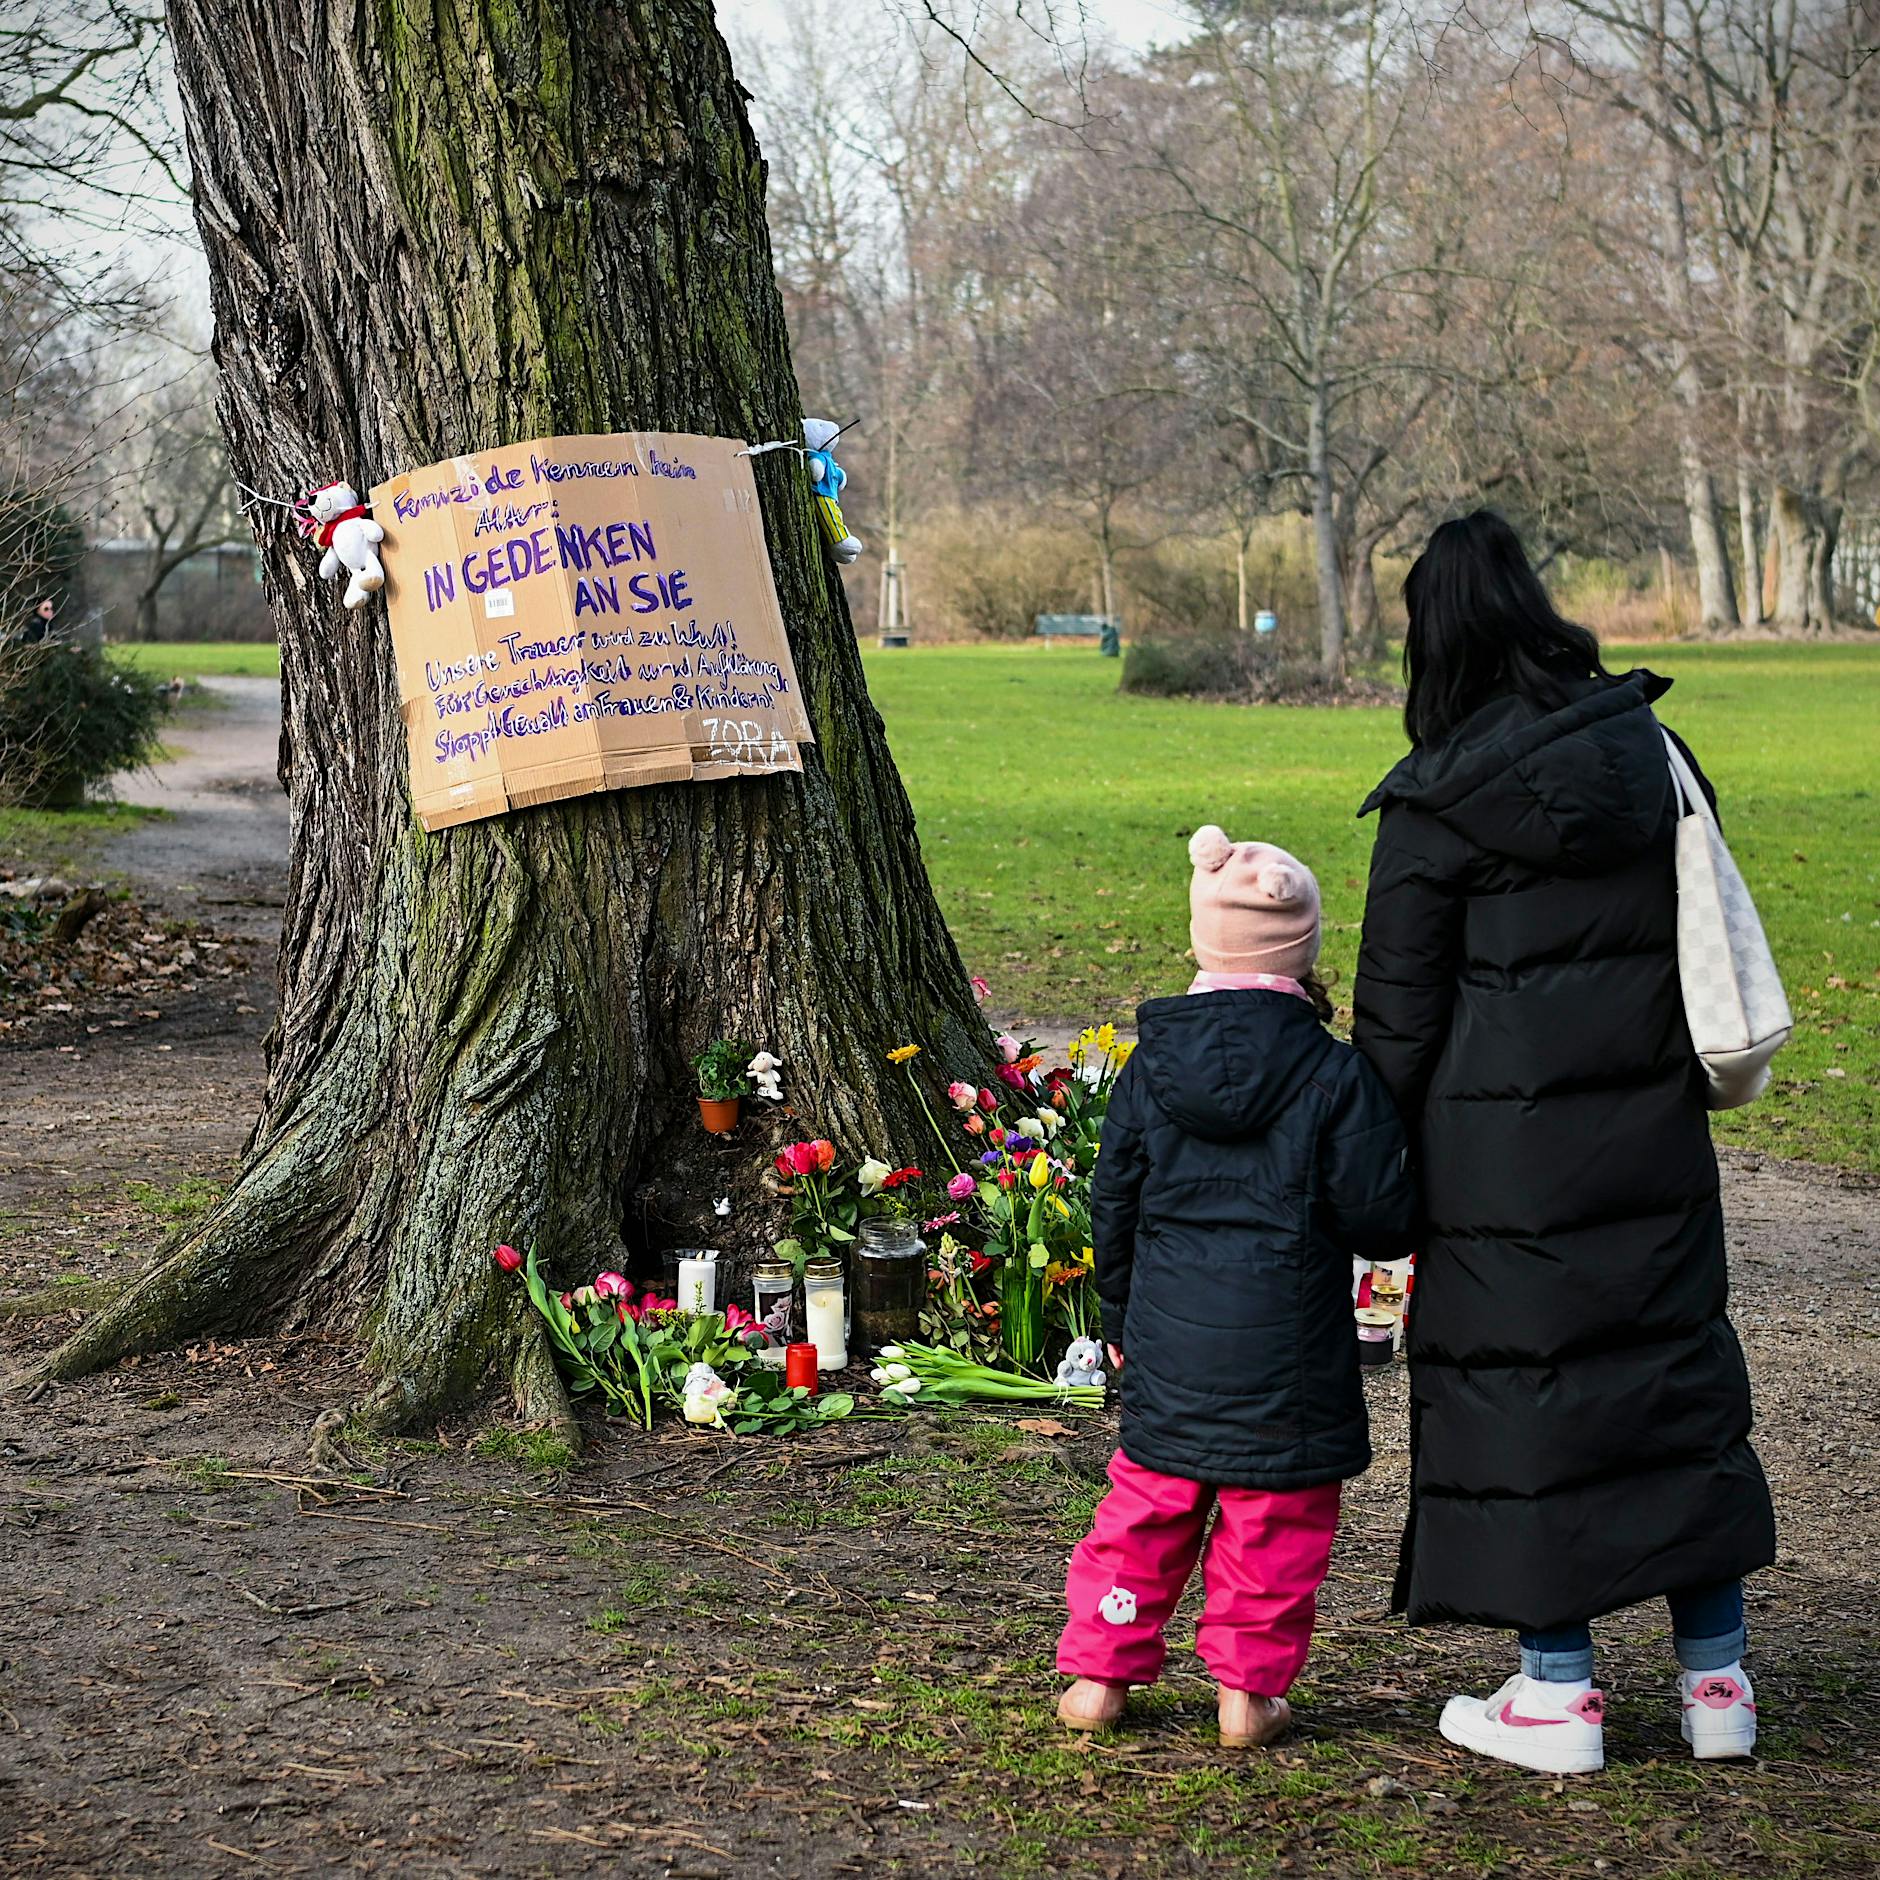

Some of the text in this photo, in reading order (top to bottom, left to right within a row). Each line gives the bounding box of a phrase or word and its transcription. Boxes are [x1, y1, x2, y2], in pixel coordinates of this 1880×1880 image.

[424, 563, 455, 612] IN
[461, 520, 656, 595] GEDENKEN
[574, 569, 693, 618] AN SIE
[425, 619, 738, 692] Unsere Trauer wird zu Wut!
[638, 653, 694, 682] und
[573, 703, 600, 723] an
[695, 682, 776, 711] Kindern!
[702, 717, 796, 769] ZORA
